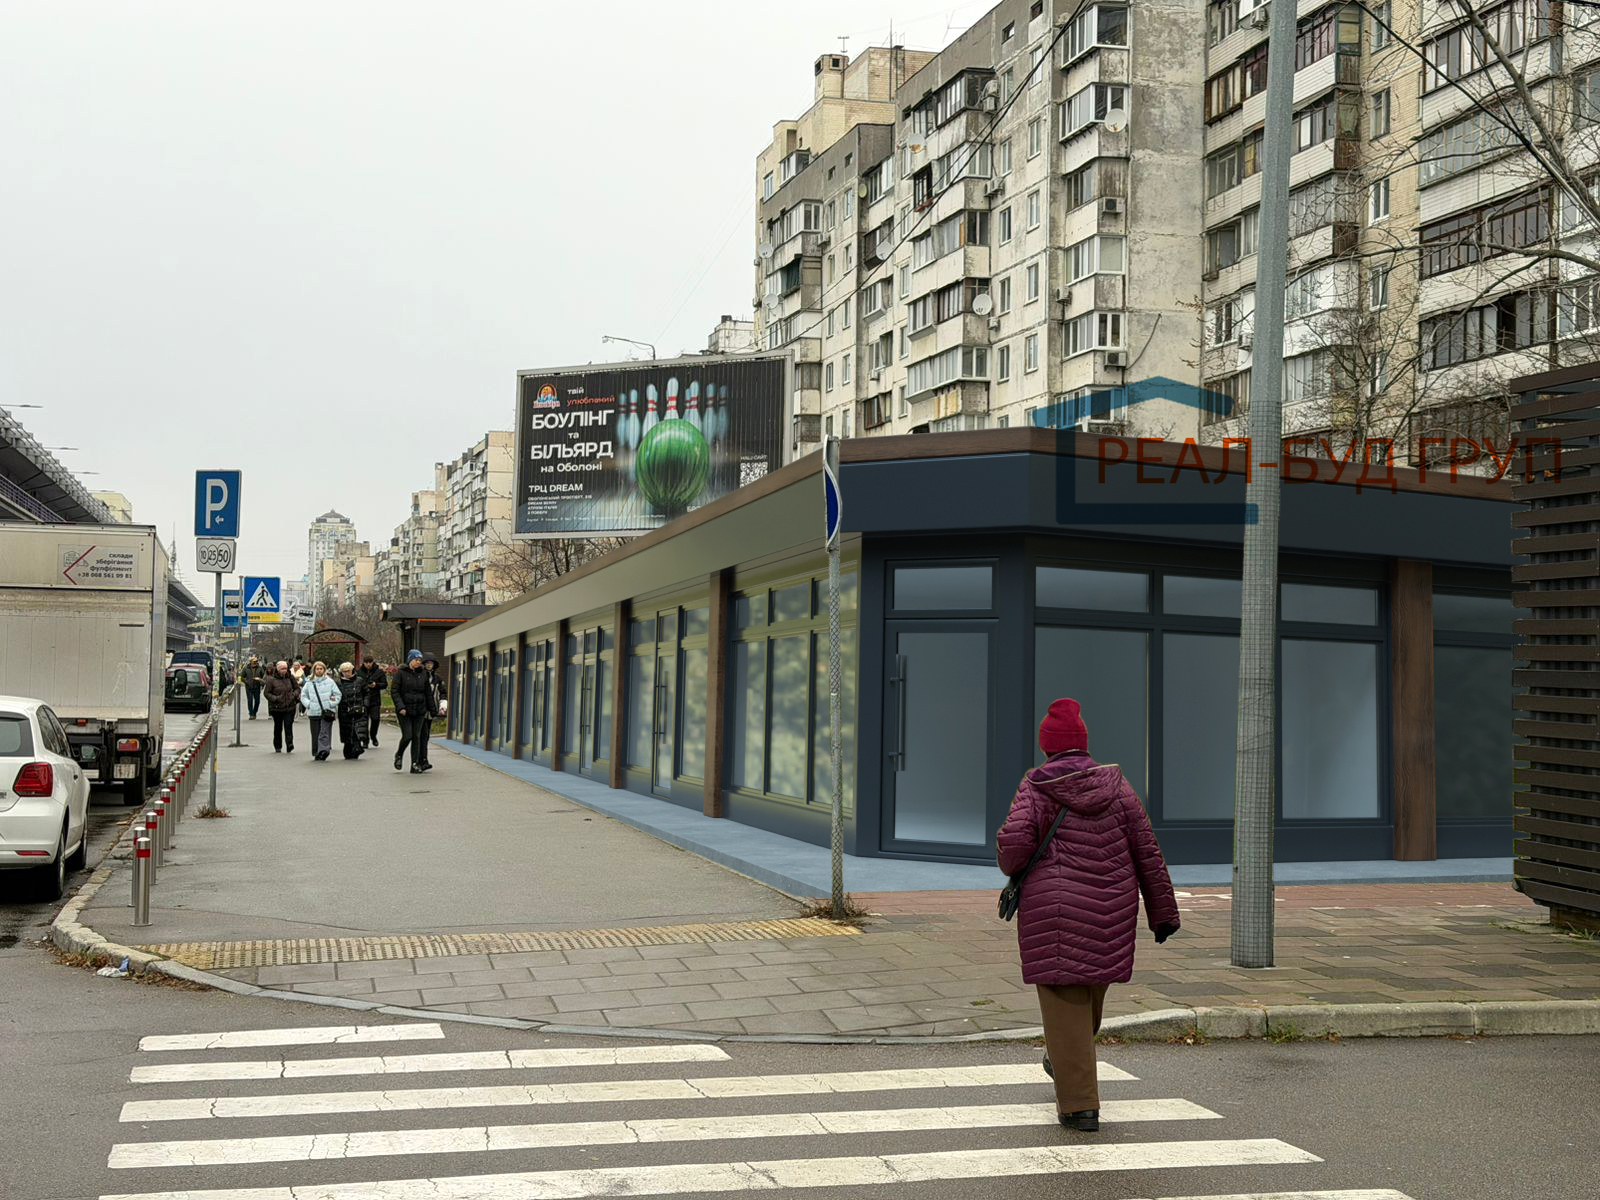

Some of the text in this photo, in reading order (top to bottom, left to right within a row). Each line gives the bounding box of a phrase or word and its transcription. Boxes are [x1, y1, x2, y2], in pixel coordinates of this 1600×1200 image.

[567, 387, 584, 395] твій
[567, 395, 615, 407] улюблений
[532, 409, 615, 430] БОУЛІНГ
[568, 432, 579, 440] та
[531, 441, 614, 460] БІЛЬЯРД
[541, 462, 602, 473] на Оболоні
[528, 483, 583, 494] ТРЦ DREAM
[205, 478, 228, 529] P
[200, 549, 229, 563] 10 25 50
